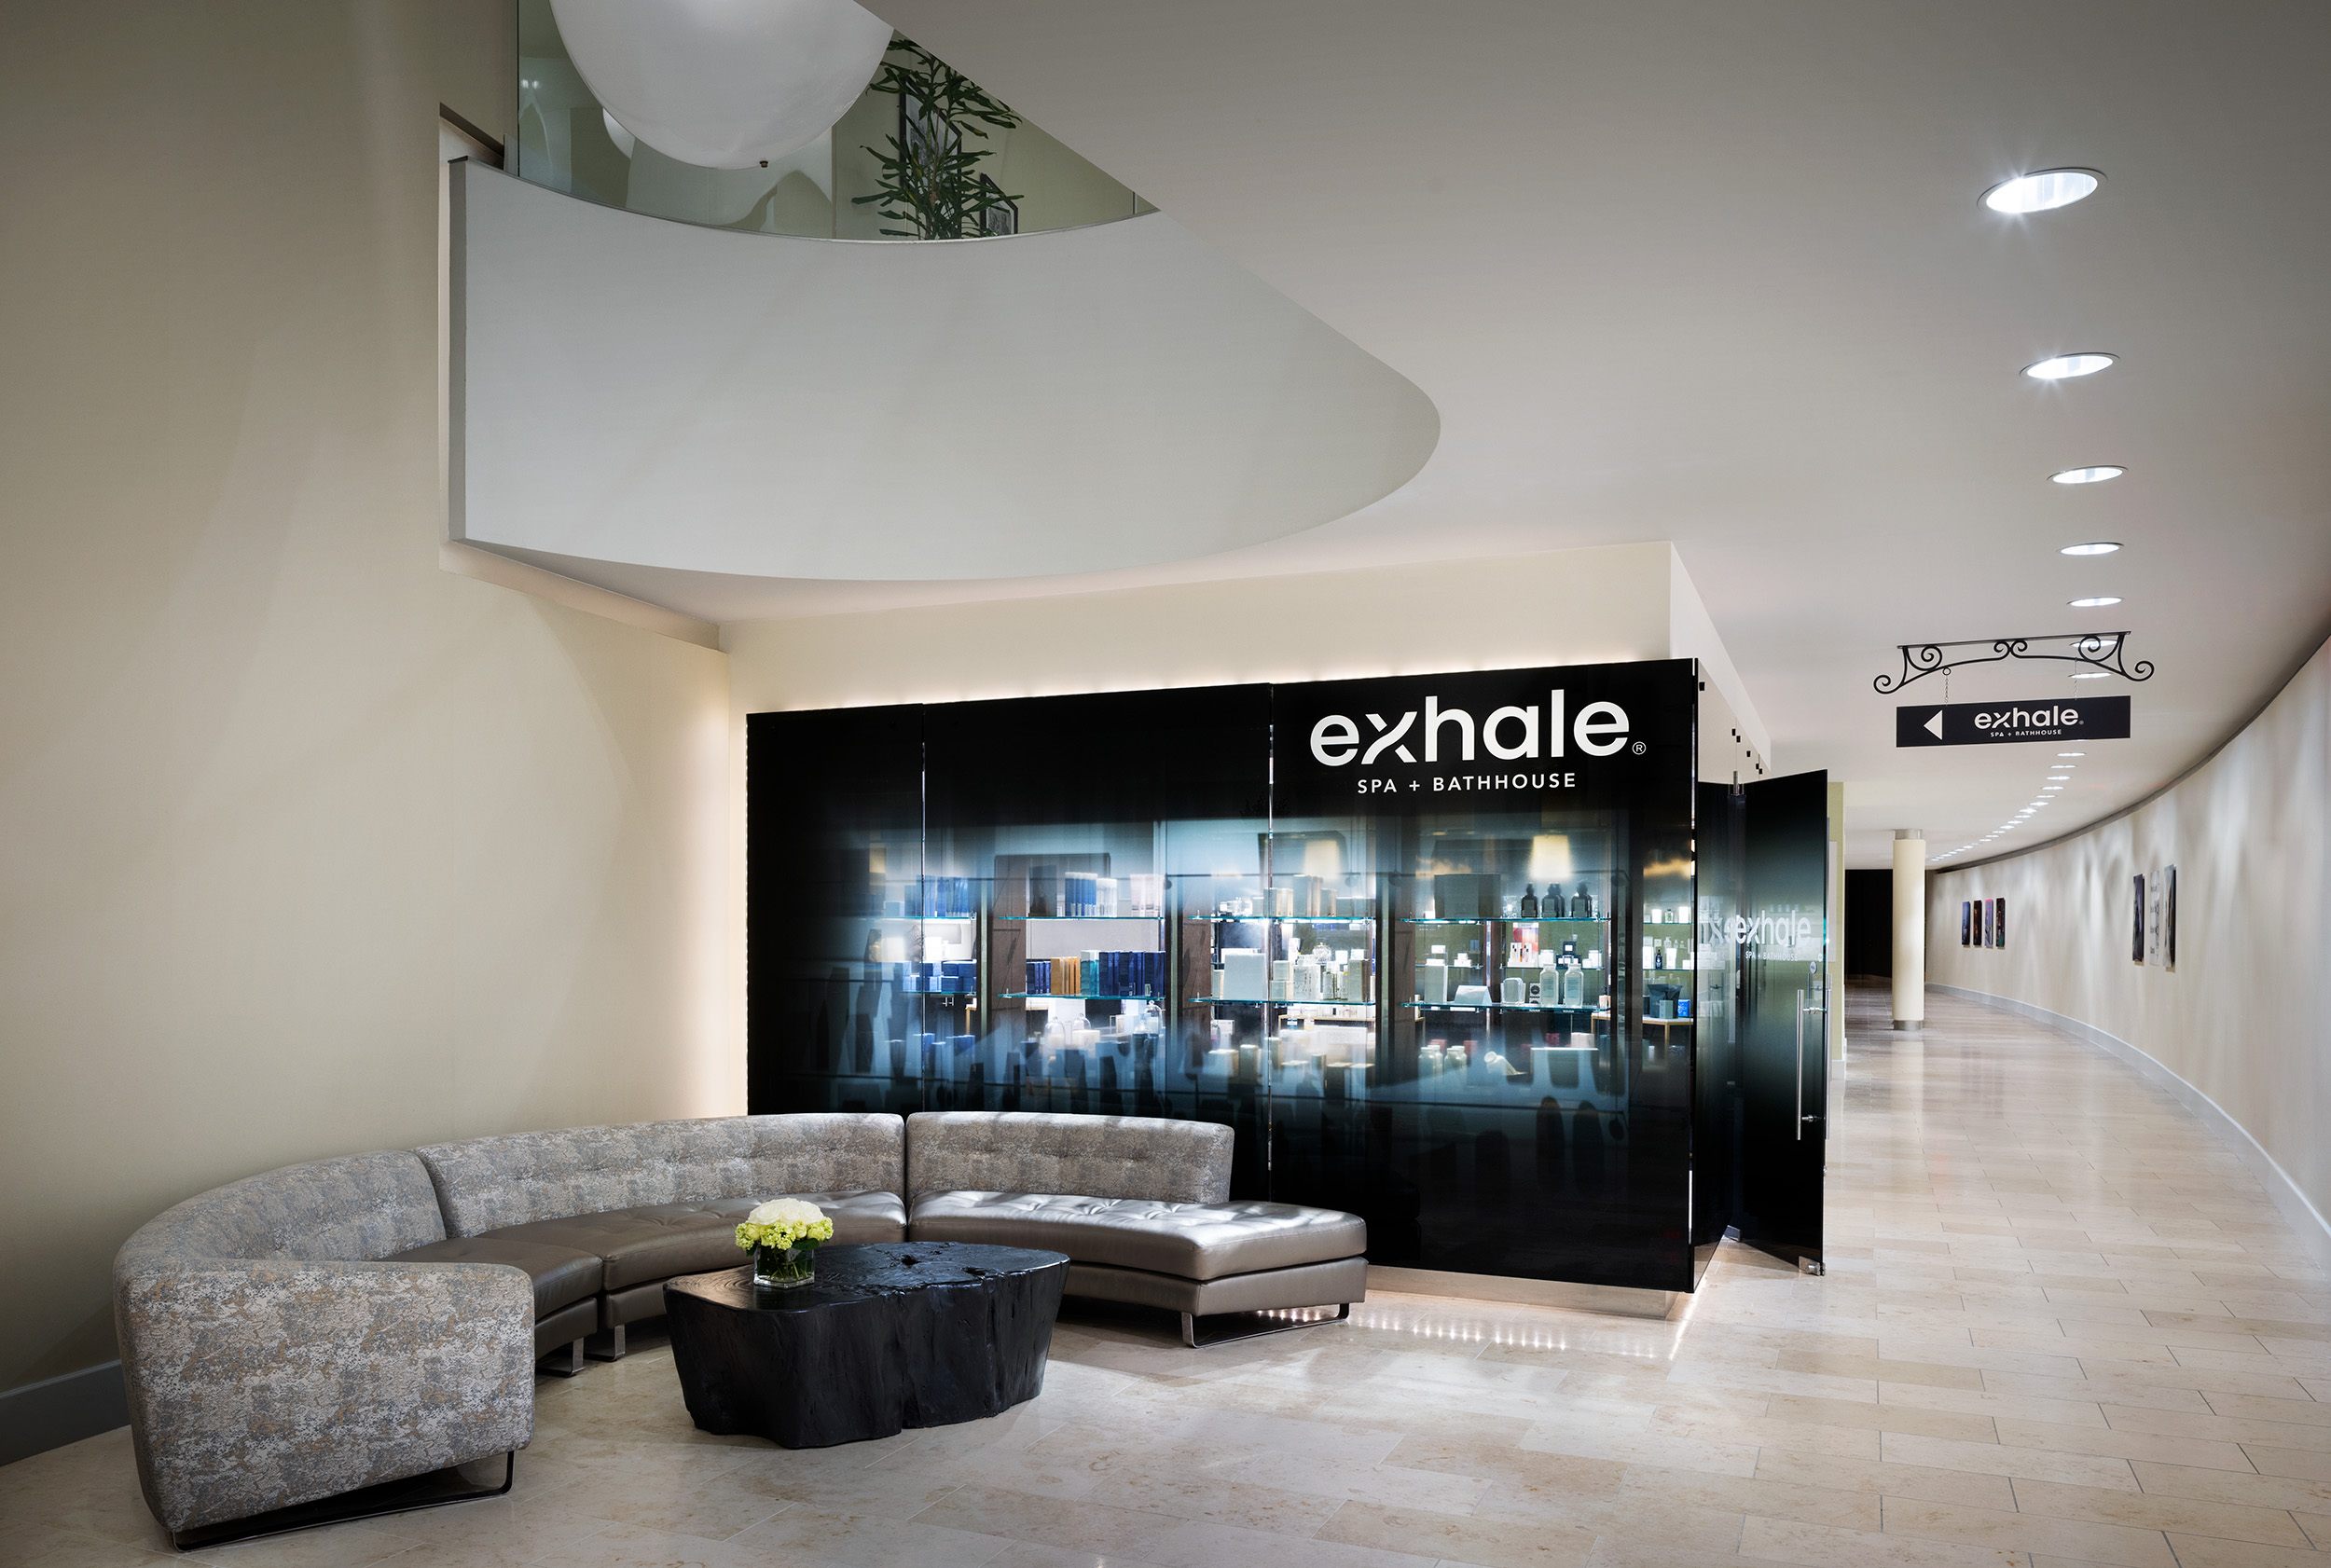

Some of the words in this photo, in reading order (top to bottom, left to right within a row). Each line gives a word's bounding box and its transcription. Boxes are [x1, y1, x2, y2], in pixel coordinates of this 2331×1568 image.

[1310, 689, 1630, 767] exhale
[1974, 705, 2079, 730] exhale
[1357, 778, 1397, 794] SPA
[1409, 780, 1420, 791] +
[1433, 773, 1576, 792] BATHHOUSE
[1735, 910, 1812, 947] exhale
[1745, 950, 1757, 960] SPA
